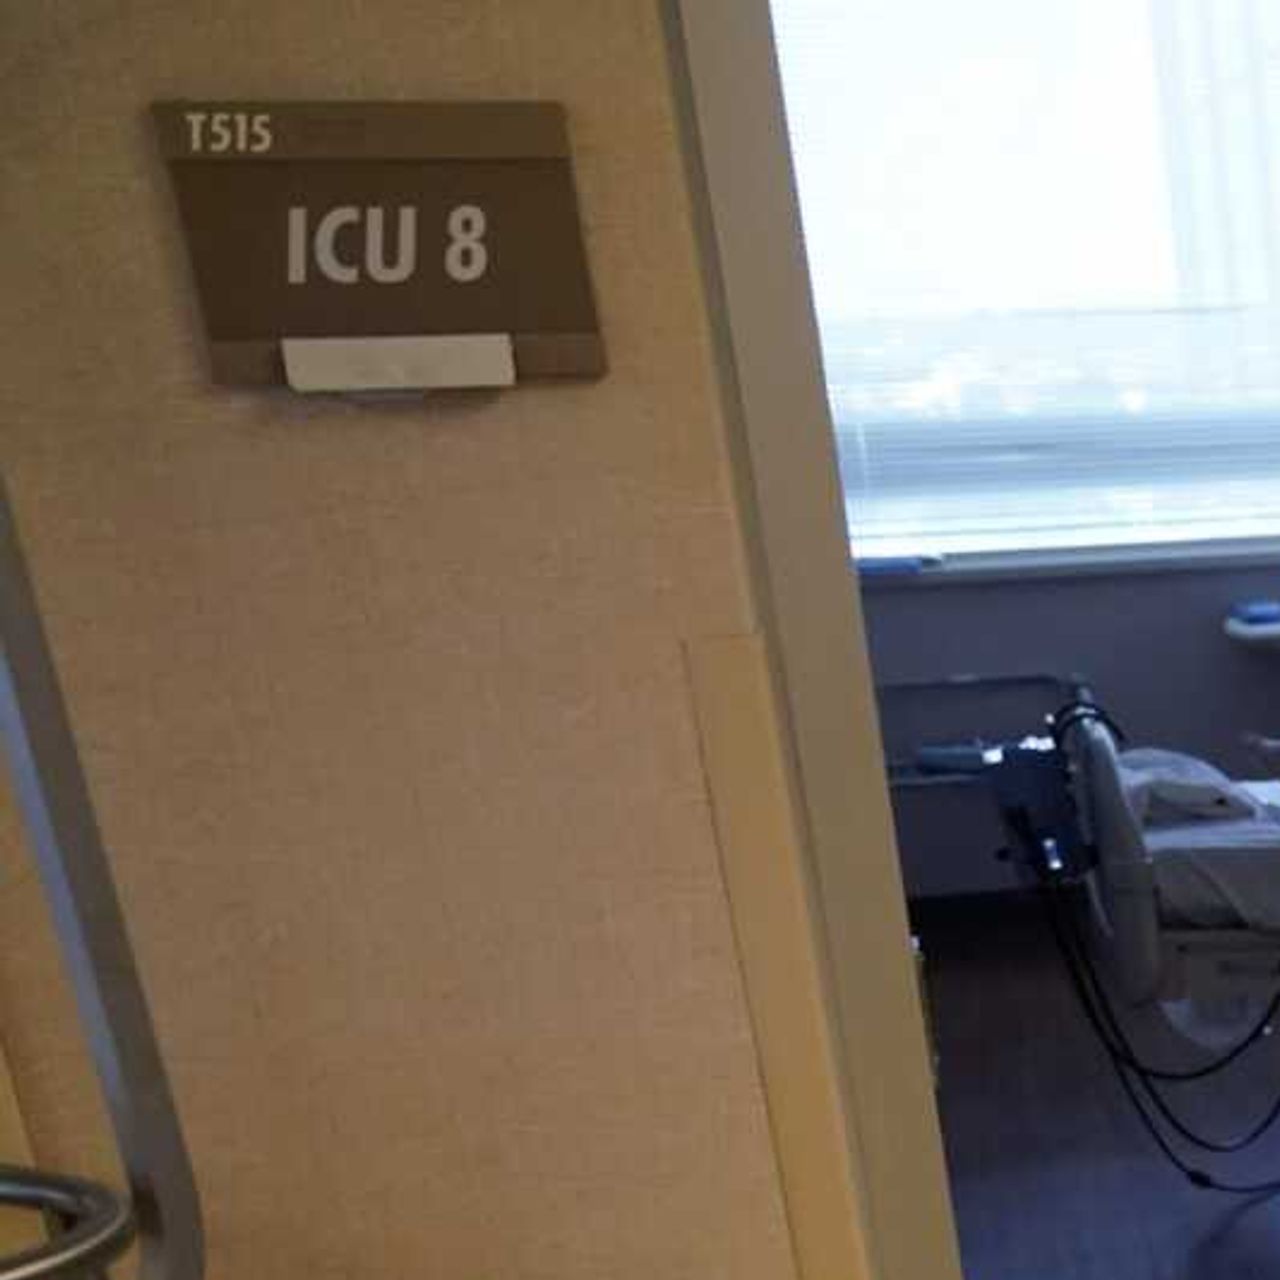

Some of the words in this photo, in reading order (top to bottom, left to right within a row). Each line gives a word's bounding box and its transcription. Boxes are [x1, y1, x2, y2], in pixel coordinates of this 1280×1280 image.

[186, 113, 273, 152] T515
[287, 205, 418, 284] ICU
[444, 204, 489, 283] 8
